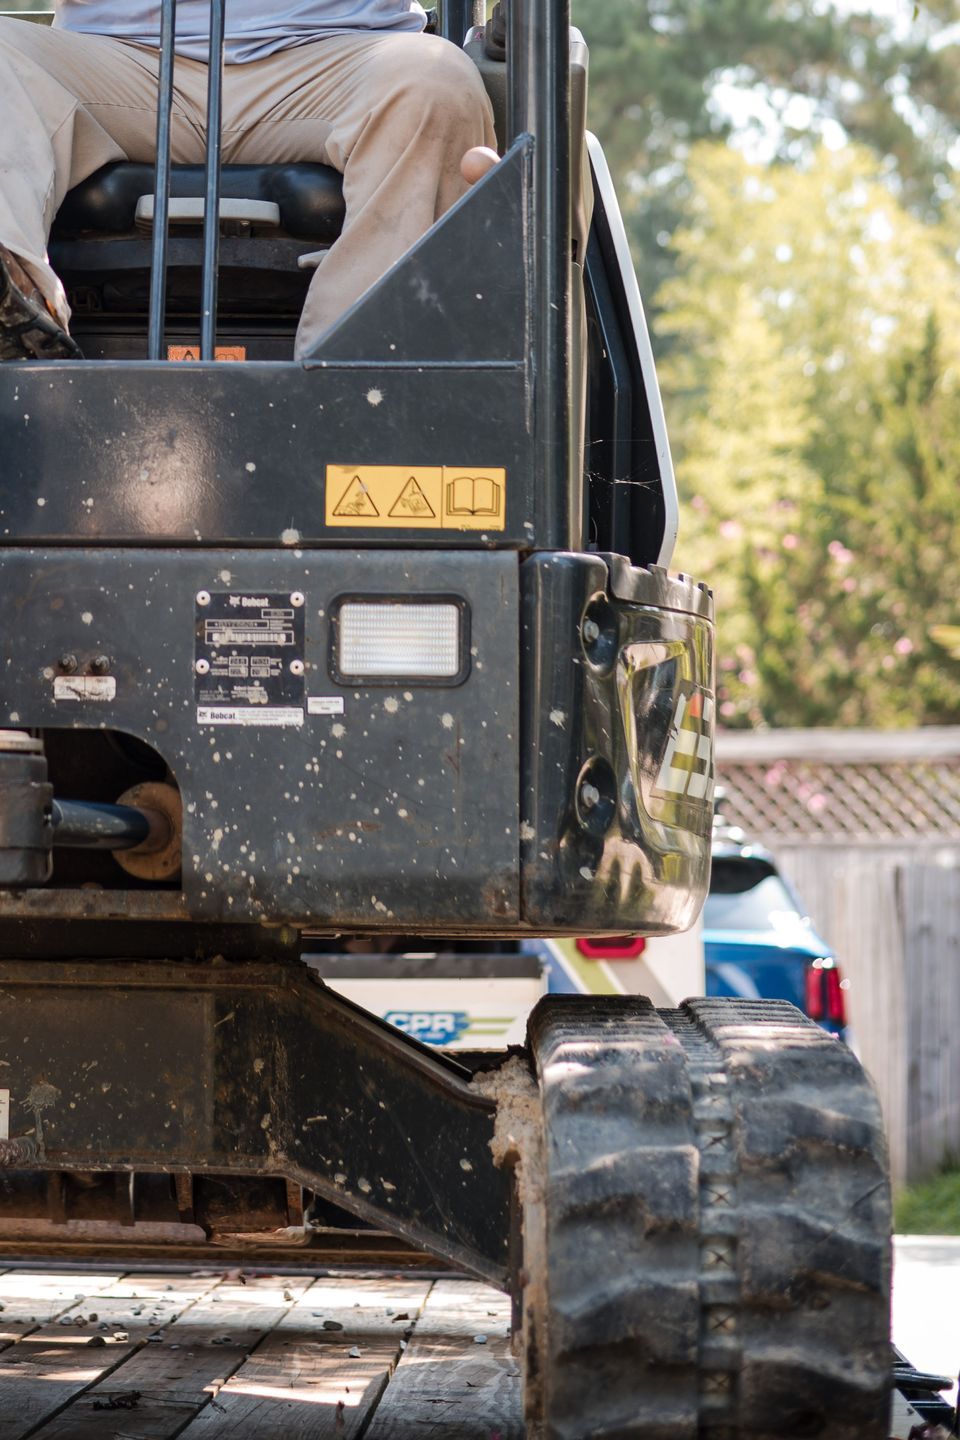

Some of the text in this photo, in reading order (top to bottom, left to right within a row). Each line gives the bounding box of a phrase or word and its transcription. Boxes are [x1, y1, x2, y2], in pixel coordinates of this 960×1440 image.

[241, 597, 269, 608] Bobcat
[210, 711, 236, 720] Bobcat
[385, 1013, 455, 1033] CPR
